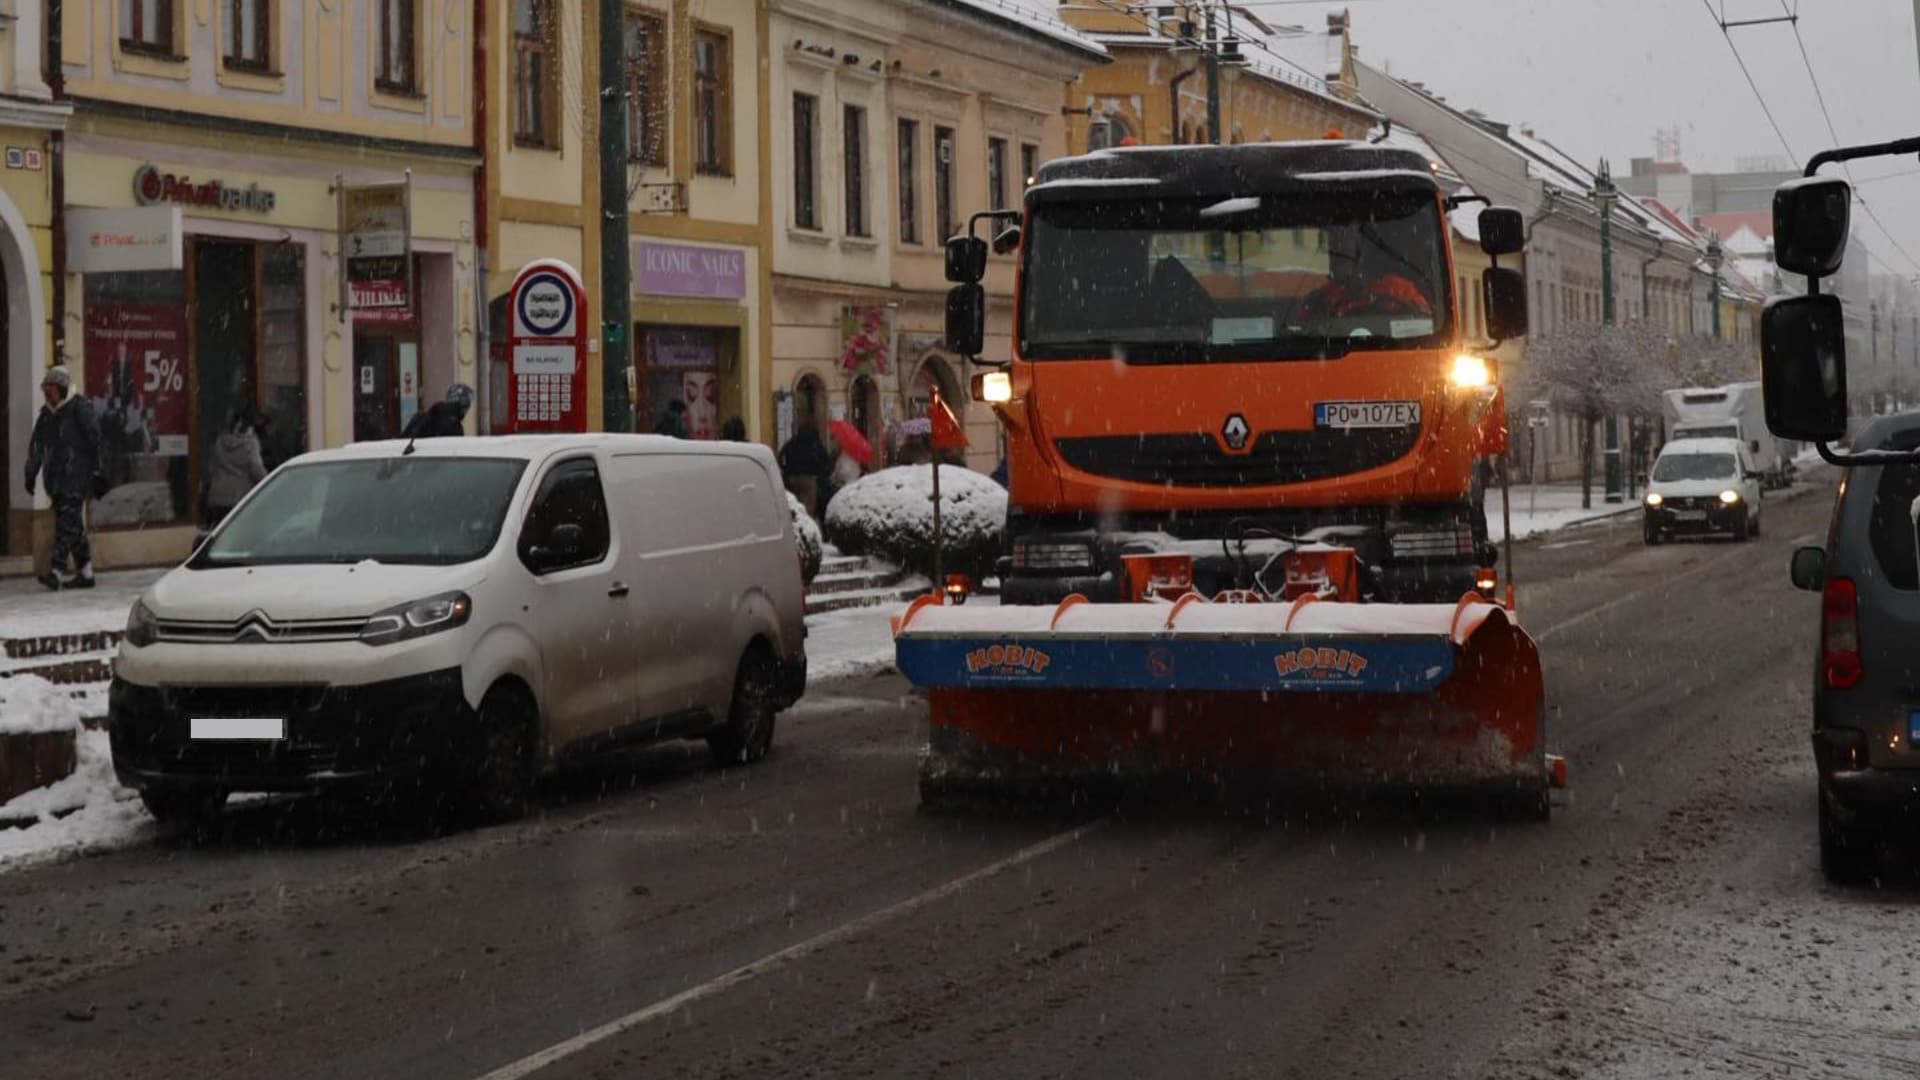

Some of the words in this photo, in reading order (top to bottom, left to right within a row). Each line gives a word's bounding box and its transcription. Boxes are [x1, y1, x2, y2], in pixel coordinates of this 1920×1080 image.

[161, 174, 275, 211] Privatbanka
[646, 247, 695, 274] ICONIC
[702, 252, 740, 277] NAILS
[143, 350, 183, 393] 5%
[966, 644, 1051, 674] KOBIT
[1274, 646, 1368, 677] KOBIT
